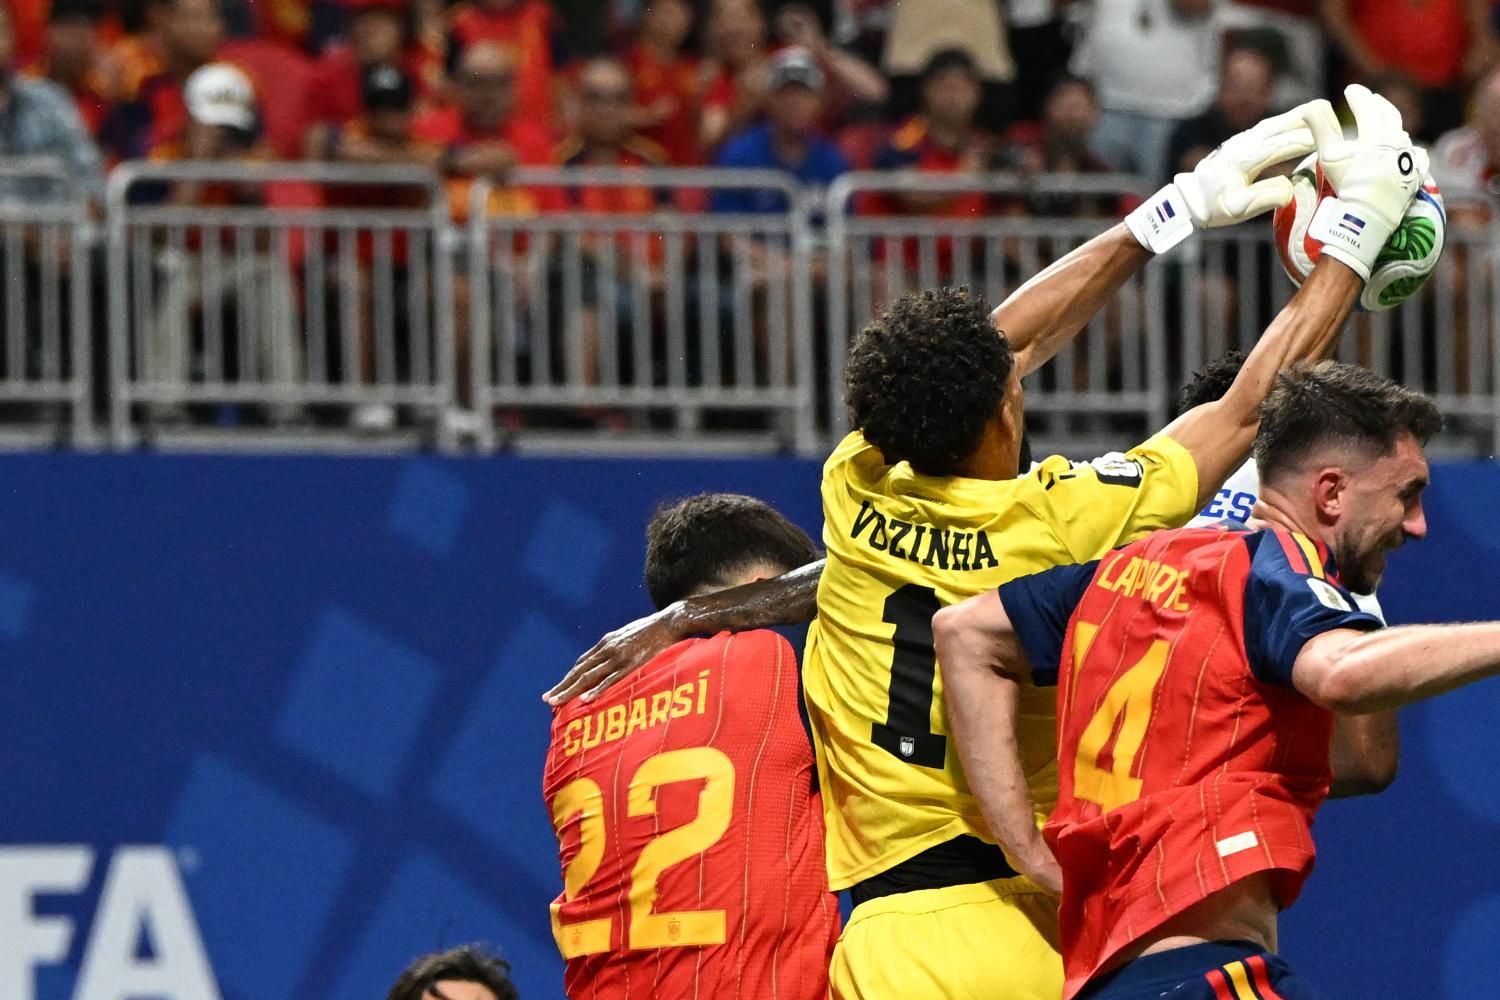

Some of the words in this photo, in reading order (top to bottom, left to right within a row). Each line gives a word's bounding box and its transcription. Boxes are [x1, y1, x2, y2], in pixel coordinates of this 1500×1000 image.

[849, 499, 999, 572] VOZINHA
[564, 668, 710, 757] CUBARSÍ
[870, 583, 947, 770] 1
[550, 745, 736, 960] 22
